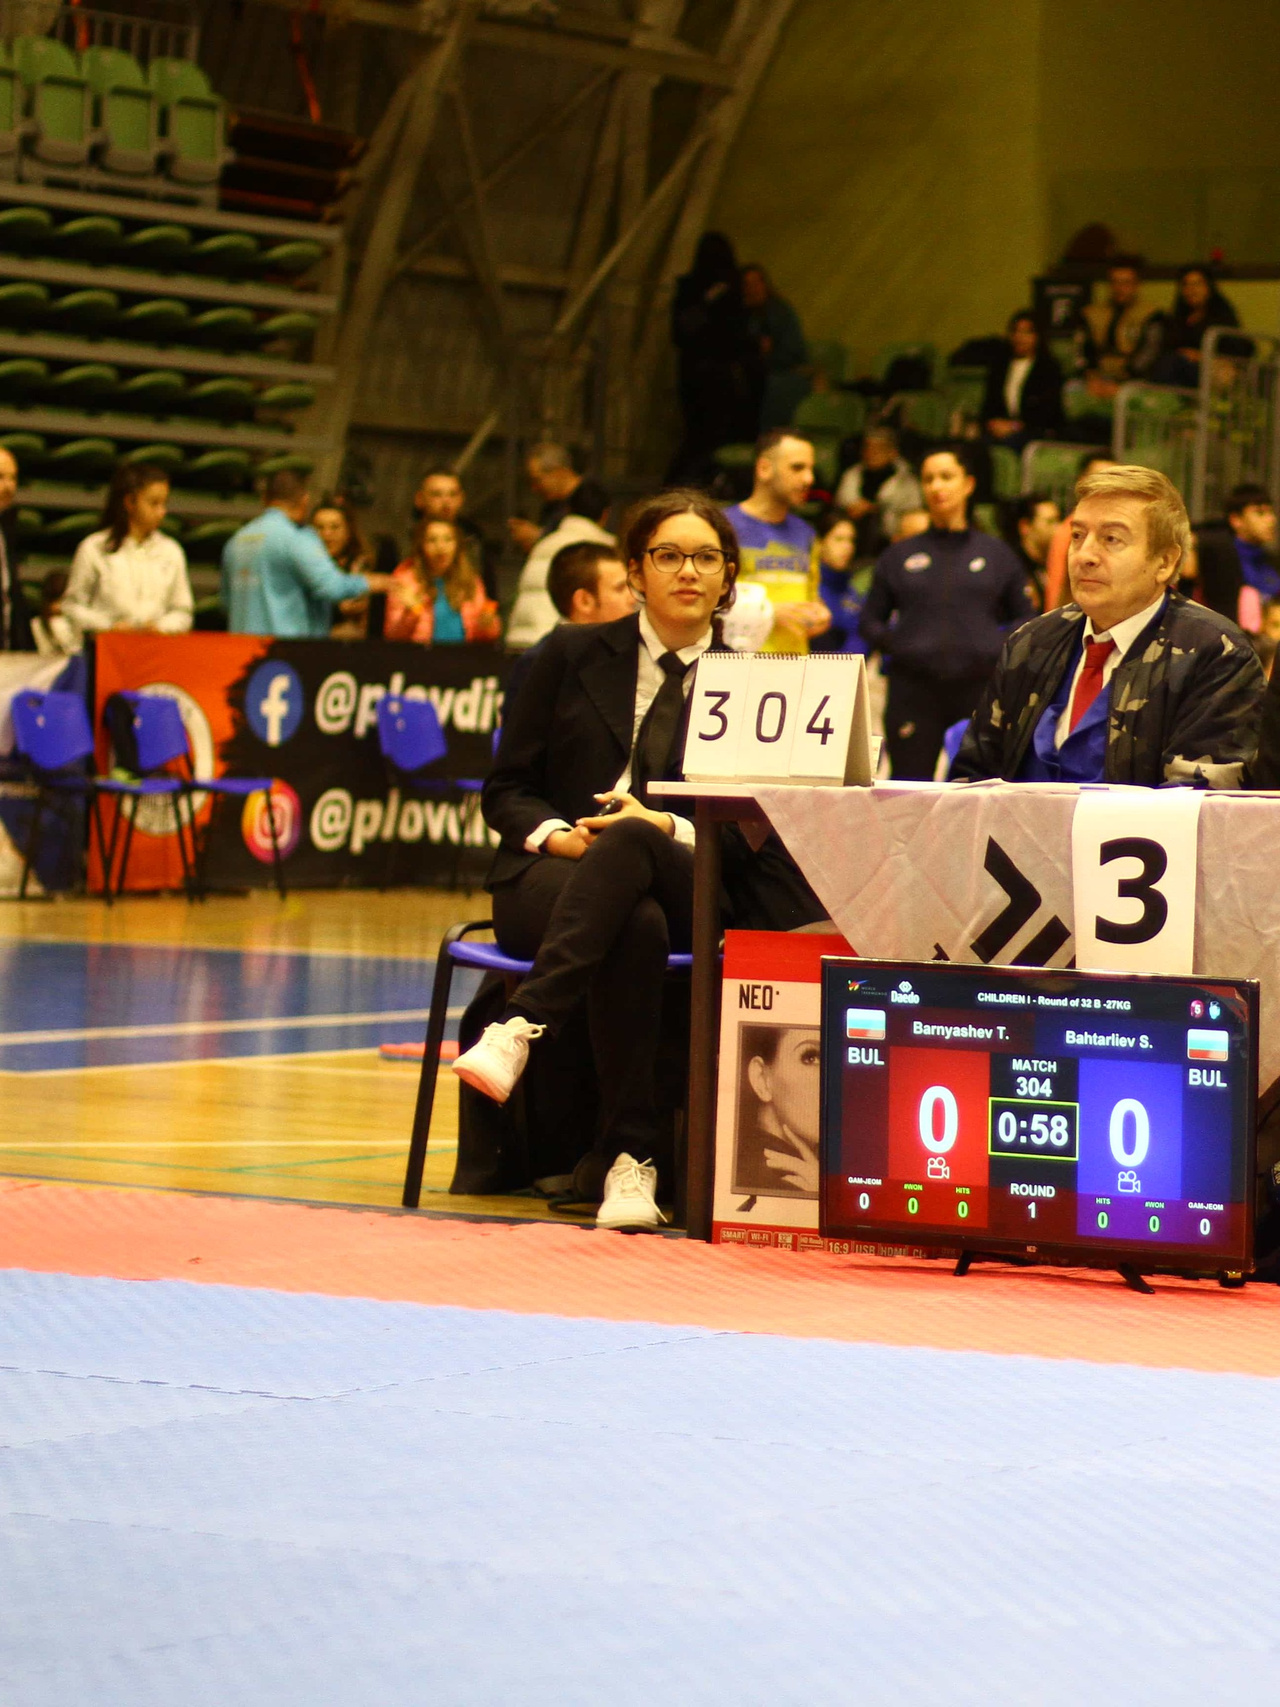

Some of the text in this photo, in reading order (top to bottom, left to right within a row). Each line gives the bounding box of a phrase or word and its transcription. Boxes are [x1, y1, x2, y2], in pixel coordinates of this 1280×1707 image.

[1095, 837, 1168, 944] 3
[739, 984, 773, 1010] NEO
[891, 990, 920, 1004] Daedo
[978, 992, 1025, 1004] CHILDREN
[1038, 996, 1067, 1007] Round
[1070, 998, 1080, 1007] of
[1081, 998, 1092, 1008] 32
[1094, 999, 1101, 1008] B
[1103, 1000, 1131, 1010] -27KG
[913, 1021, 1010, 1040] Barnyashev T.
[1066, 1030, 1153, 1048] Bahtarliev S.
[848, 1047, 884, 1066] BUL
[1012, 1059, 1057, 1073] MATCH
[1188, 1069, 1227, 1087] BUL
[1016, 1077, 1052, 1097] 304
[919, 1085, 958, 1153] 0
[998, 1112, 1068, 1146] 0:58
[1109, 1098, 1150, 1167] 0
[848, 1177, 882, 1186] GAM-JEOM
[1010, 1183, 1055, 1198] ROUND
[859, 1193, 870, 1209] 0
[908, 1198, 918, 1214] 0
[1188, 1202, 1224, 1211] GAM-JEOM
[957, 1201, 968, 1218] 0
[1028, 1202, 1036, 1218] 1
[1098, 1212, 1108, 1228] 0
[1149, 1216, 1160, 1232] 0
[1200, 1219, 1211, 1235] 0
[722, 1230, 745, 1239] SMART
[751, 1232, 769, 1241] WI-FI
[829, 1242, 849, 1254] 16:9
[856, 1244, 875, 1255] USB
